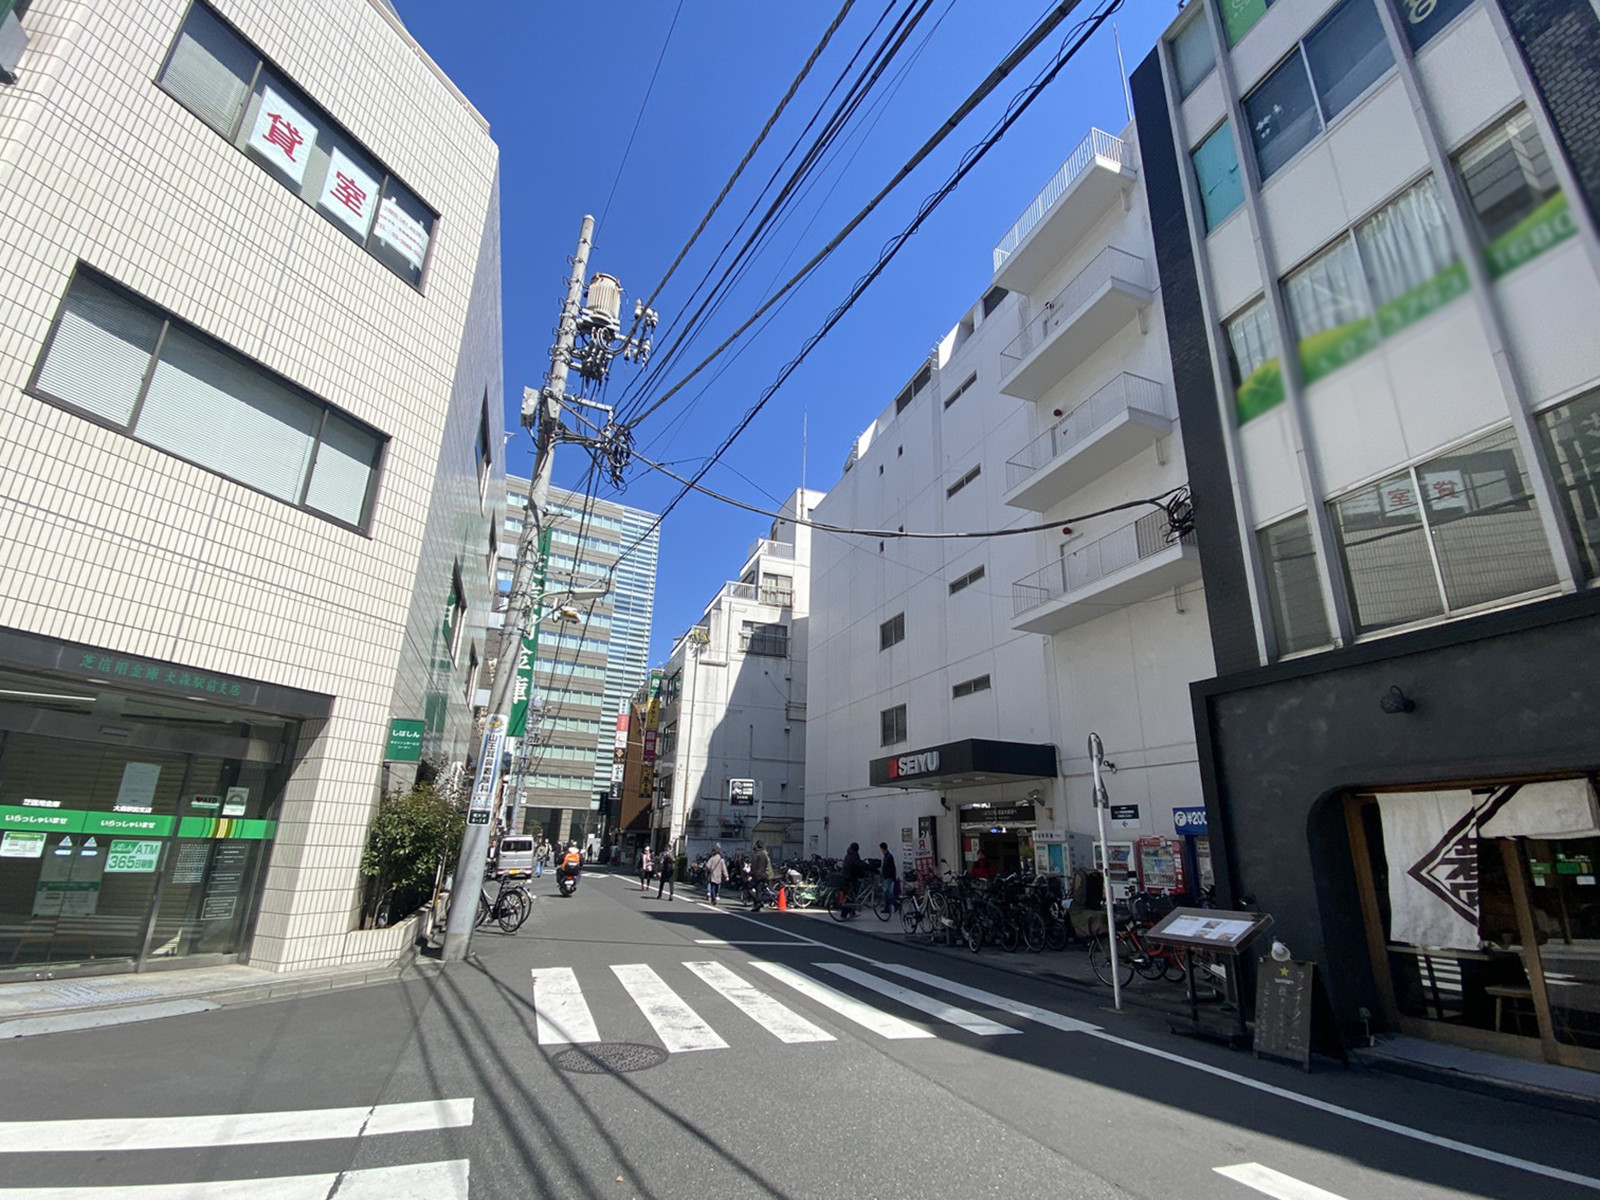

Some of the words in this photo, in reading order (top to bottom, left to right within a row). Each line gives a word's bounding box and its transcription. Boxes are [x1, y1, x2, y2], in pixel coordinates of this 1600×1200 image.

[261, 112, 304, 163] 貸
[329, 171, 367, 218] 室
[79, 653, 160, 681] 芝信用金庫
[164, 671, 242, 697] 大森駅前支店
[392, 729, 420, 738] しばしん
[898, 751, 940, 777] SEIYU
[5, 814, 68, 825] いらっしゃいませ
[100, 819, 156, 829] いらっしゃいませ
[135, 844, 158, 855] ATM
